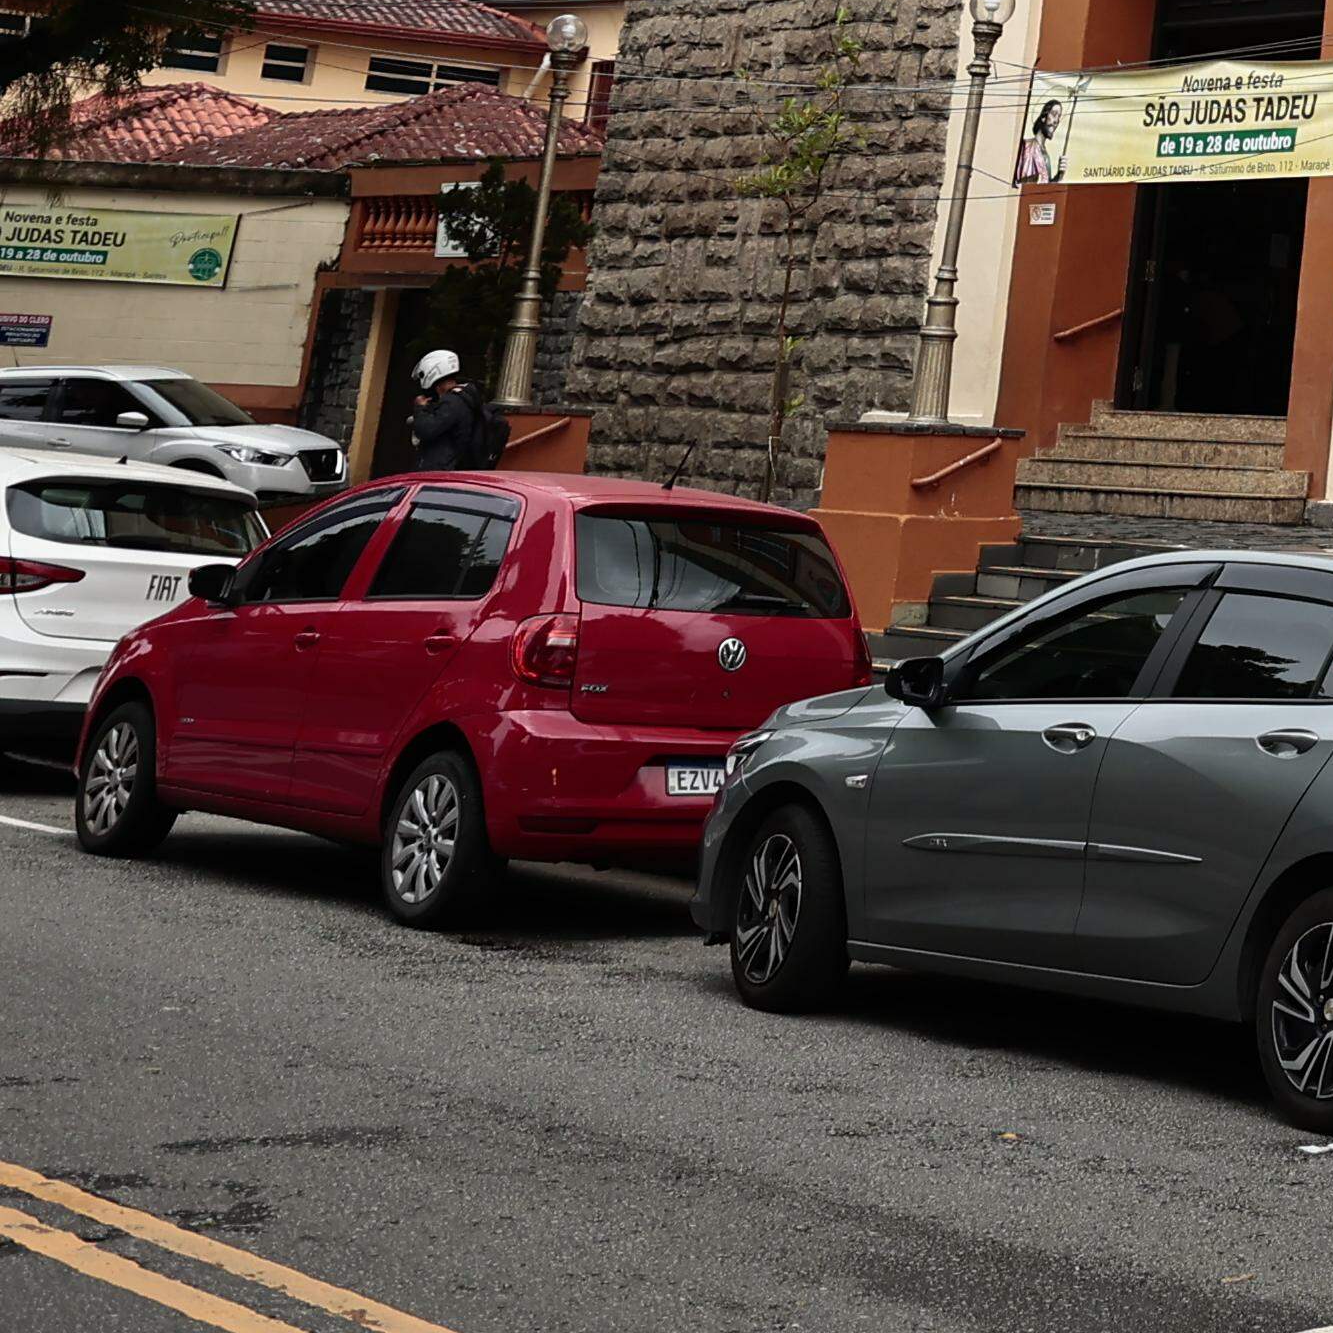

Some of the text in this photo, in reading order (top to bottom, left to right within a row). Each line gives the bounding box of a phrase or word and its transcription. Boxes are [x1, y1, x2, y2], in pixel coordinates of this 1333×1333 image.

[1181, 70, 1284, 94] Novena e festa
[1143, 93, 1318, 128] SÃO JUDAS TADEU
[1160, 130, 1292, 155] de 19 a 28 de outubro
[1083, 164, 1125, 178] SANTUÁRIO
[1126, 163, 1141, 177] SÃO
[1142, 165, 1168, 177] JUDAS
[1246, 162, 1256, 173] de
[1279, 160, 1294, 172] 112
[1300, 158, 1330, 172] Marapé
[4, 210, 98, 227] Novena e festa
[5, 226, 126, 248] JUDAS TADEU
[0, 247, 104, 264] 19 a 28 de outubro
[146, 574, 182, 601] FIAT
